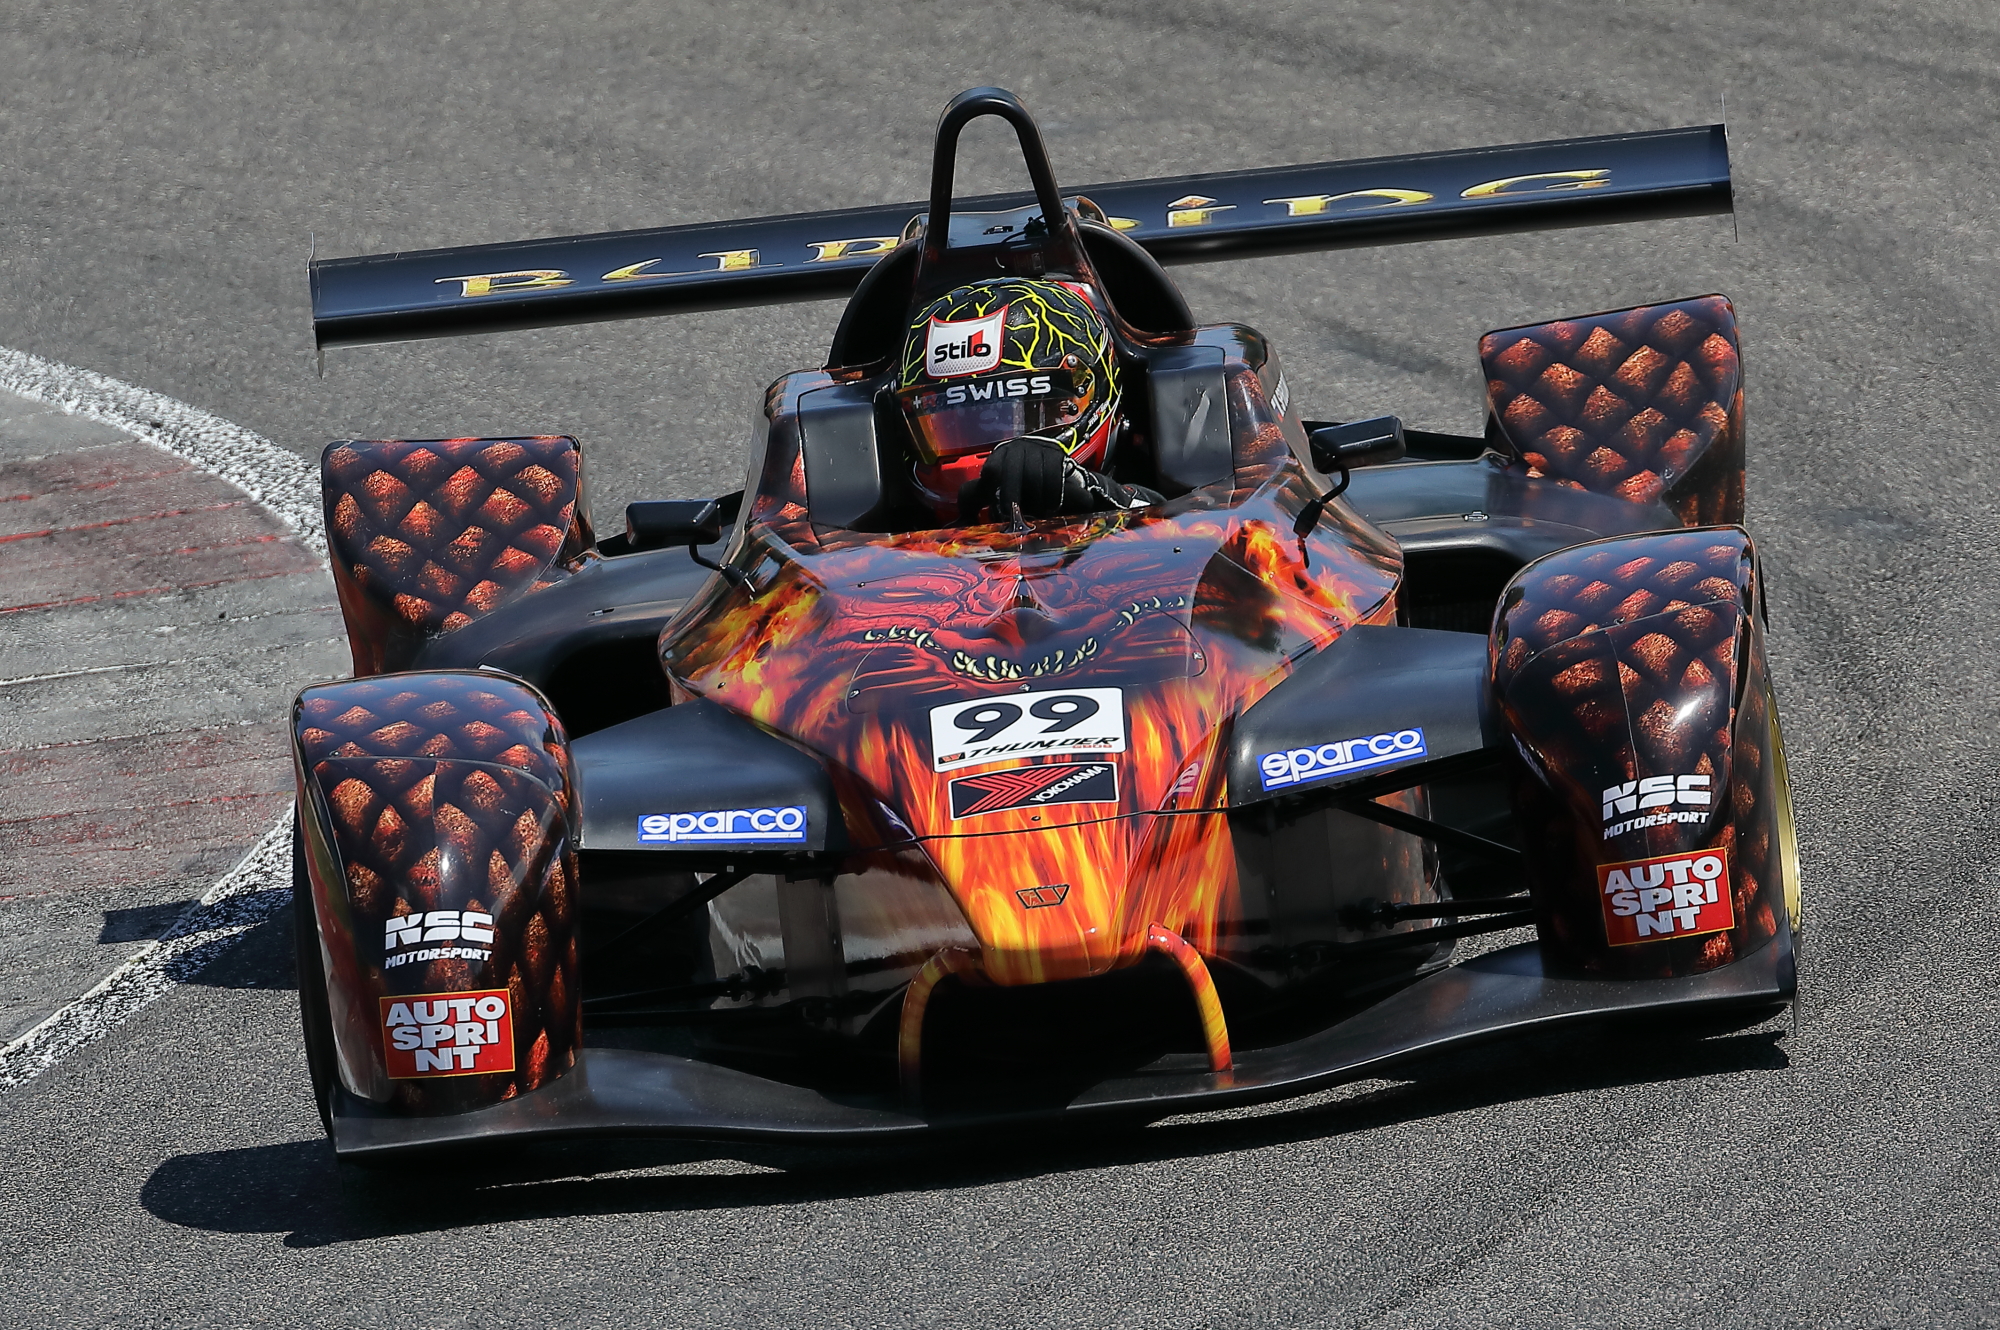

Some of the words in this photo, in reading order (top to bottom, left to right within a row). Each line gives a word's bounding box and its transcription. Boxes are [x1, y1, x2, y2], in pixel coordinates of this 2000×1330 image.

[934, 329, 993, 364] Stilo
[946, 375, 1052, 405] SWISS
[953, 694, 1100, 746] 99
[968, 736, 1121, 759] THUNDER
[1261, 729, 1422, 783] sparco
[1029, 764, 1109, 803] YOKOHAMA
[1602, 774, 1712, 822] NSC
[641, 807, 804, 842] sparco
[1603, 811, 1710, 841] MOTORSPORT
[1604, 855, 1723, 894] AUTO
[1611, 879, 1719, 917] SPRI
[385, 910, 495, 950] NSC
[1635, 906, 1701, 937] NT
[384, 947, 493, 970] MOTORSPORT
[385, 995, 506, 1027] AUTO
[391, 1019, 499, 1051] SPRI
[414, 1045, 481, 1072] NT
